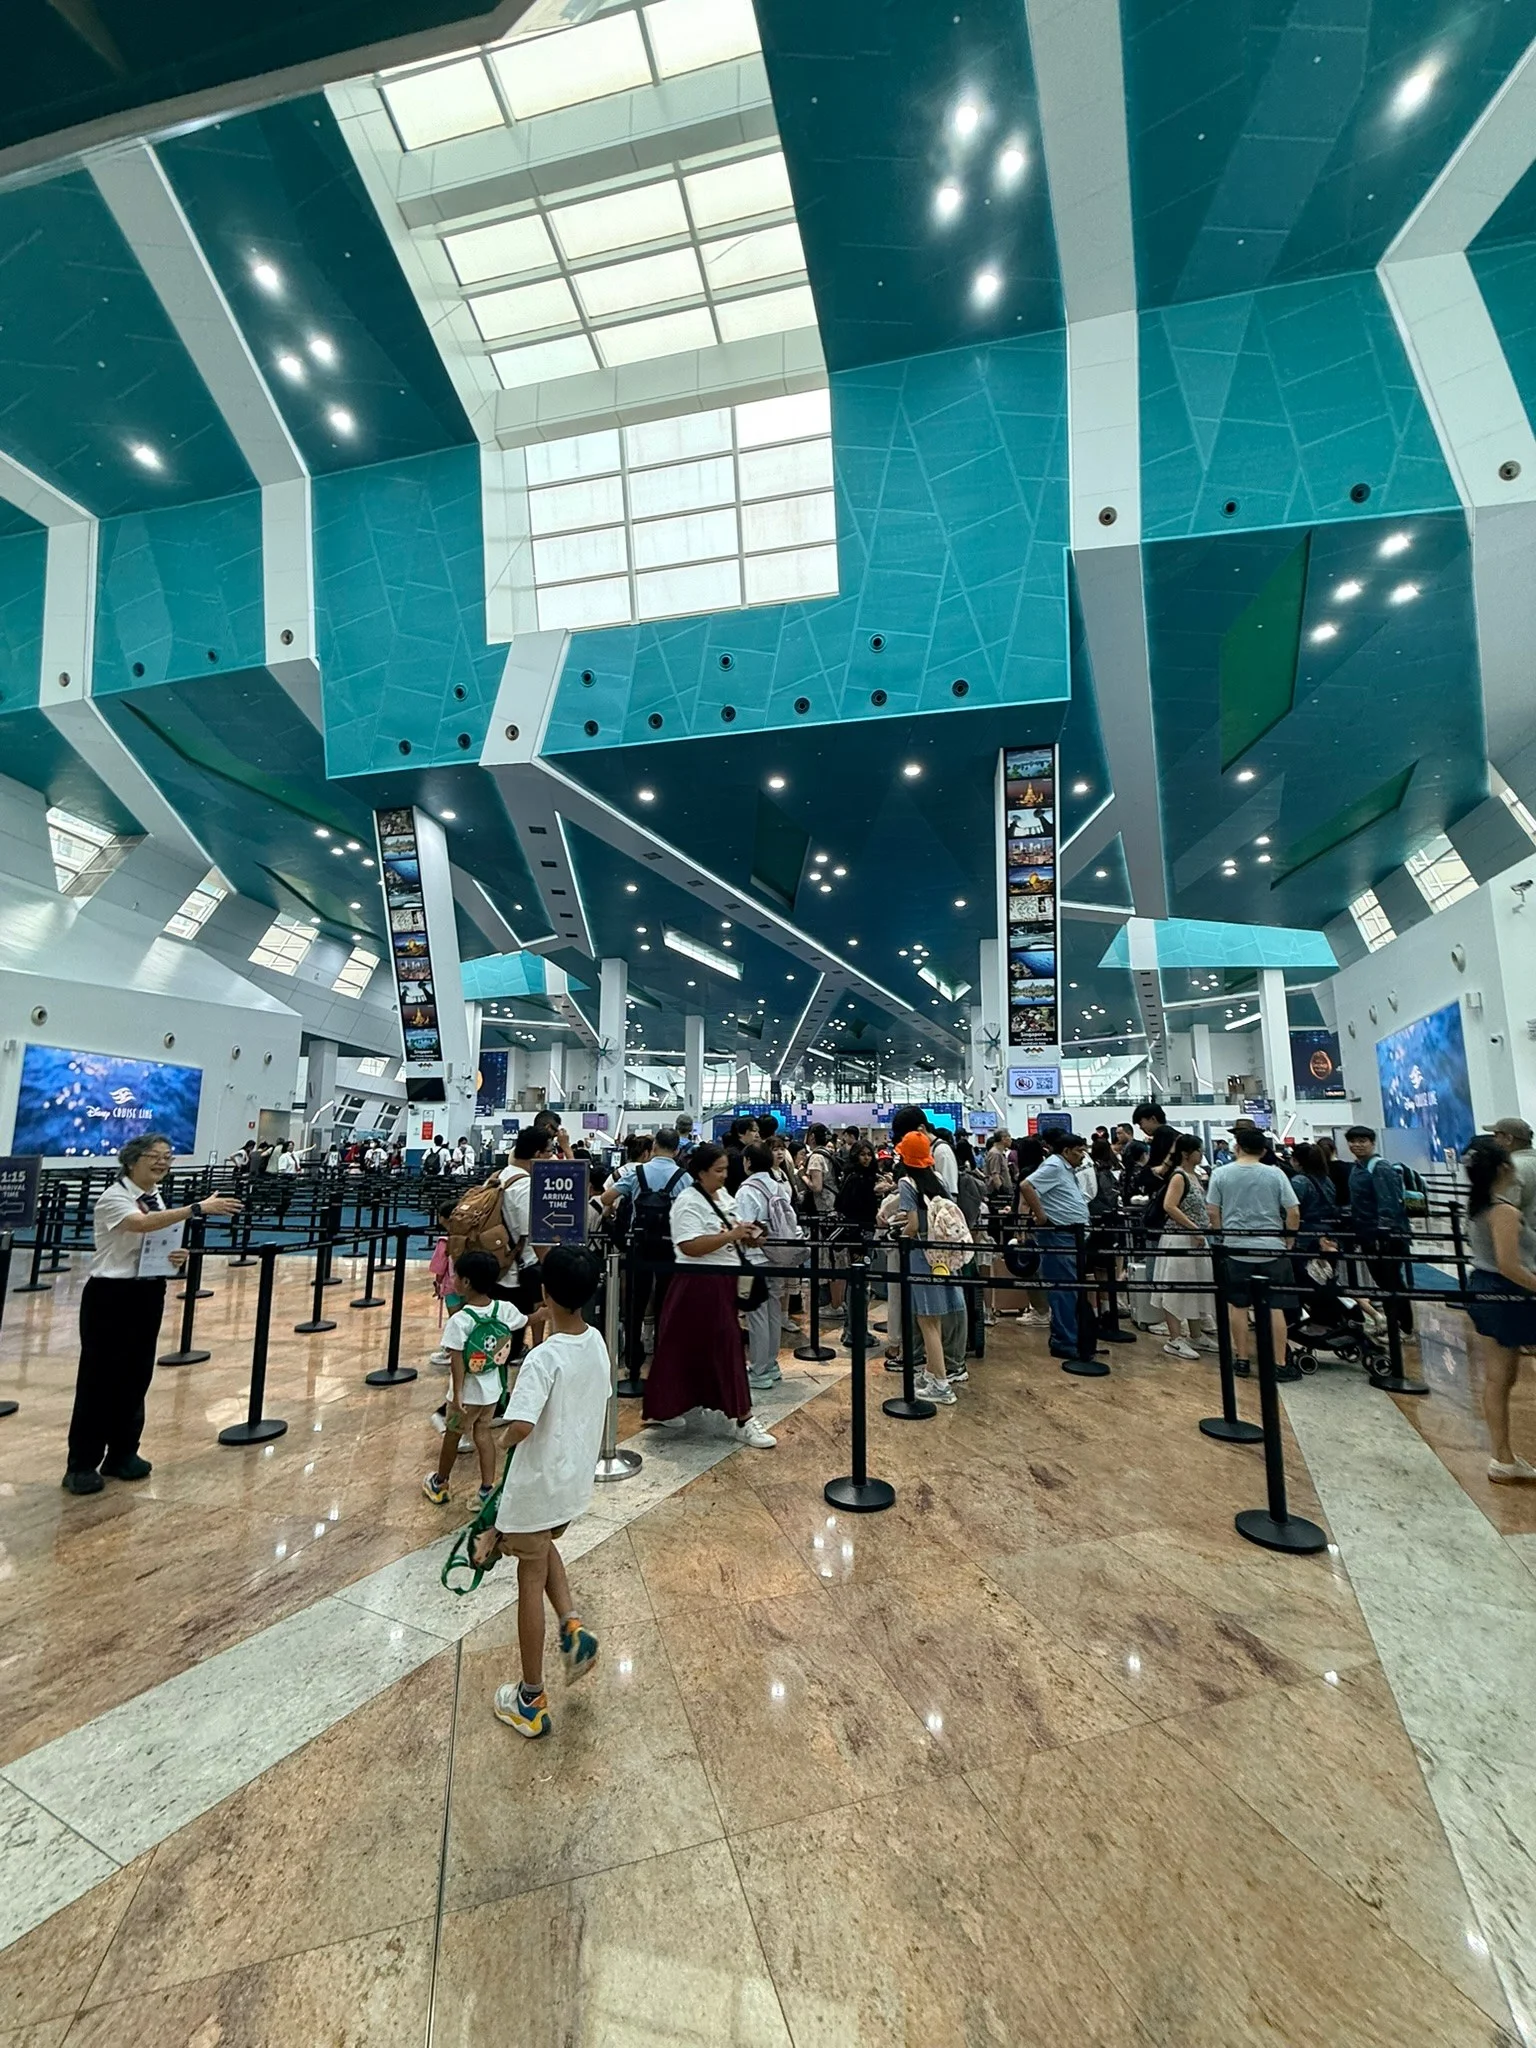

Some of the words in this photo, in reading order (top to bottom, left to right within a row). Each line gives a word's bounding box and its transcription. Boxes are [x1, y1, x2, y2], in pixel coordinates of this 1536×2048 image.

[85, 1105, 110, 1120] Disney
[112, 1107, 137, 1119] CRUISE
[138, 1108, 153, 1119] LINE
[0, 1171, 26, 1183] 1:15
[543, 1177, 574, 1191] 1:00
[542, 1193, 575, 1201] ARRIVAL
[549, 1201, 568, 1209] TIME
